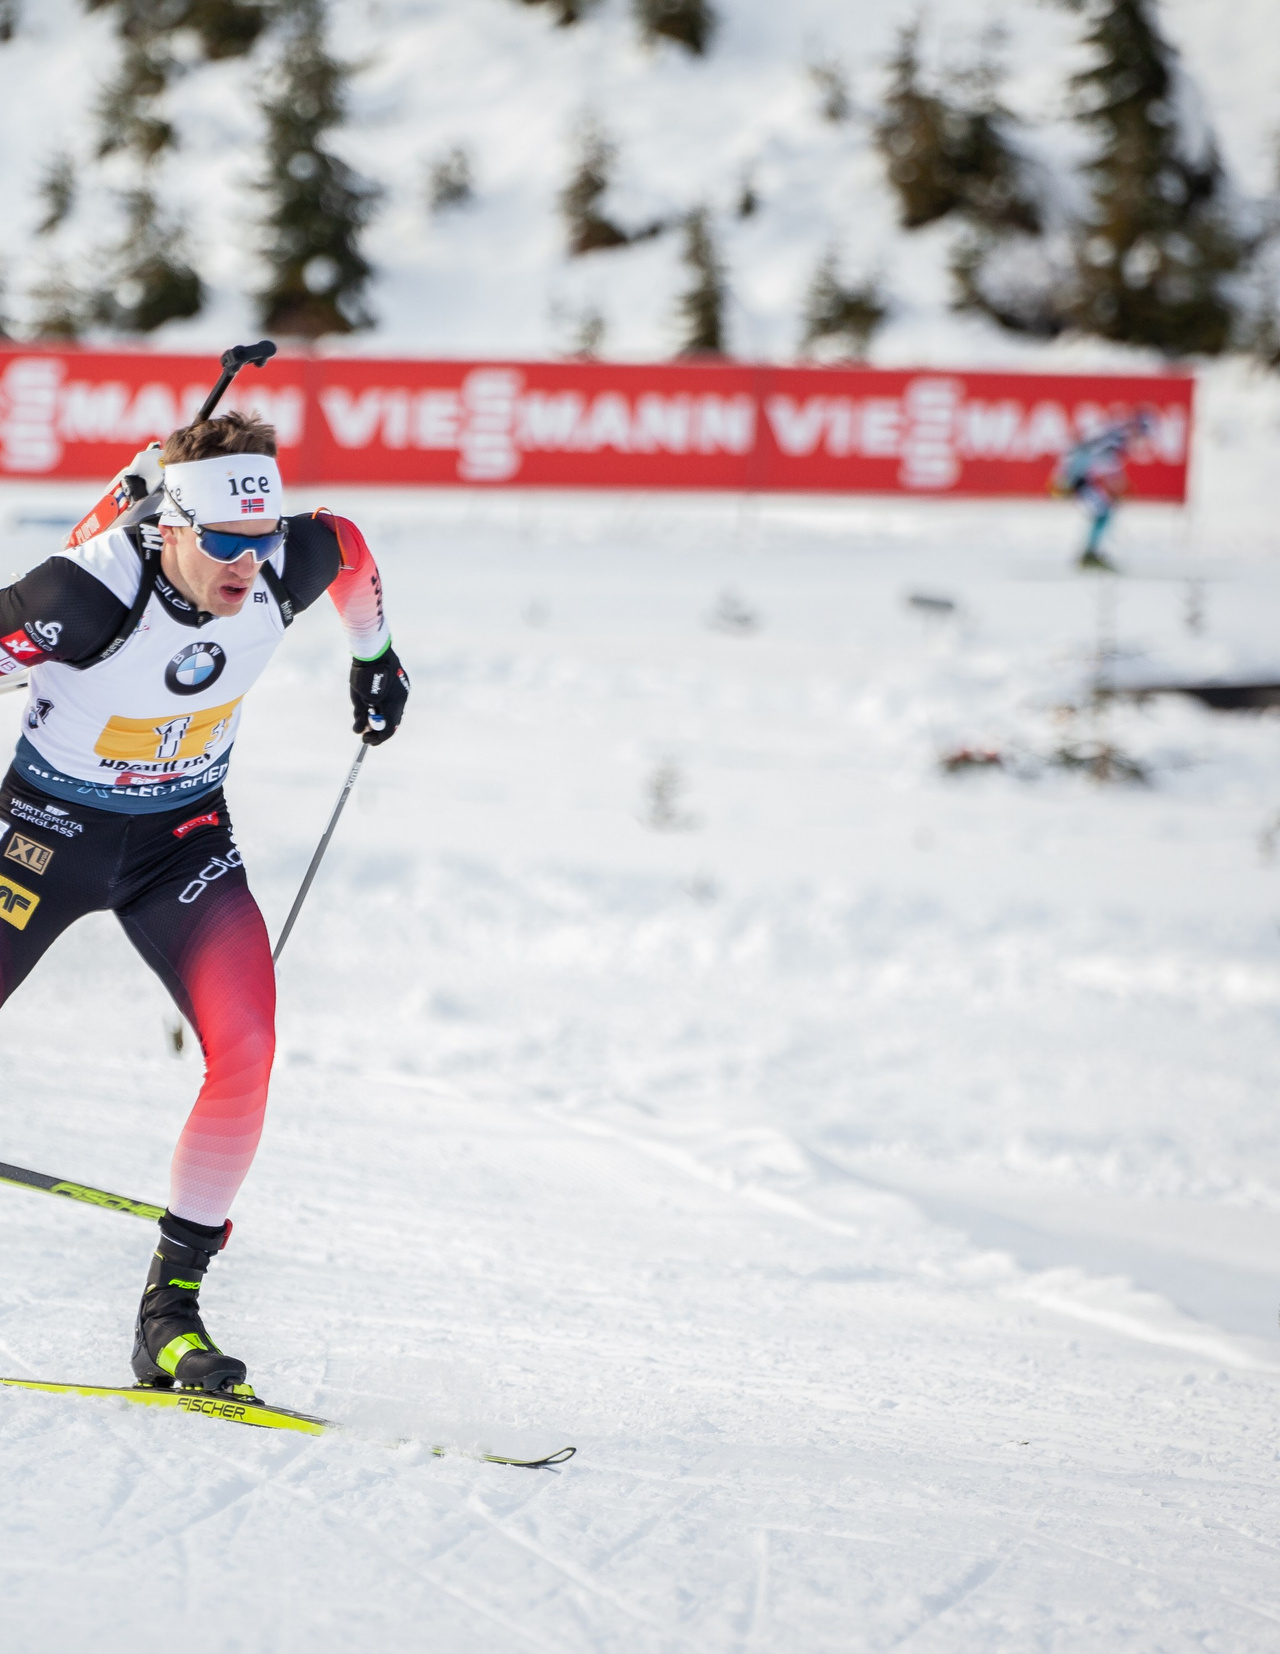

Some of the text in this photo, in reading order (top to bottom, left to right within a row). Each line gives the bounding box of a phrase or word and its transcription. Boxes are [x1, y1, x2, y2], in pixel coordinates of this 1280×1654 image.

[319, 367, 758, 482] VIESSMANN
[227, 469, 271, 496] ice
[153, 715, 193, 760] 1
[10, 797, 84, 834] HURTIGRUTA
[10, 808, 76, 838] CARGLASS
[7, 837, 44, 869] XL
[176, 1397, 246, 1421] FISCHER
